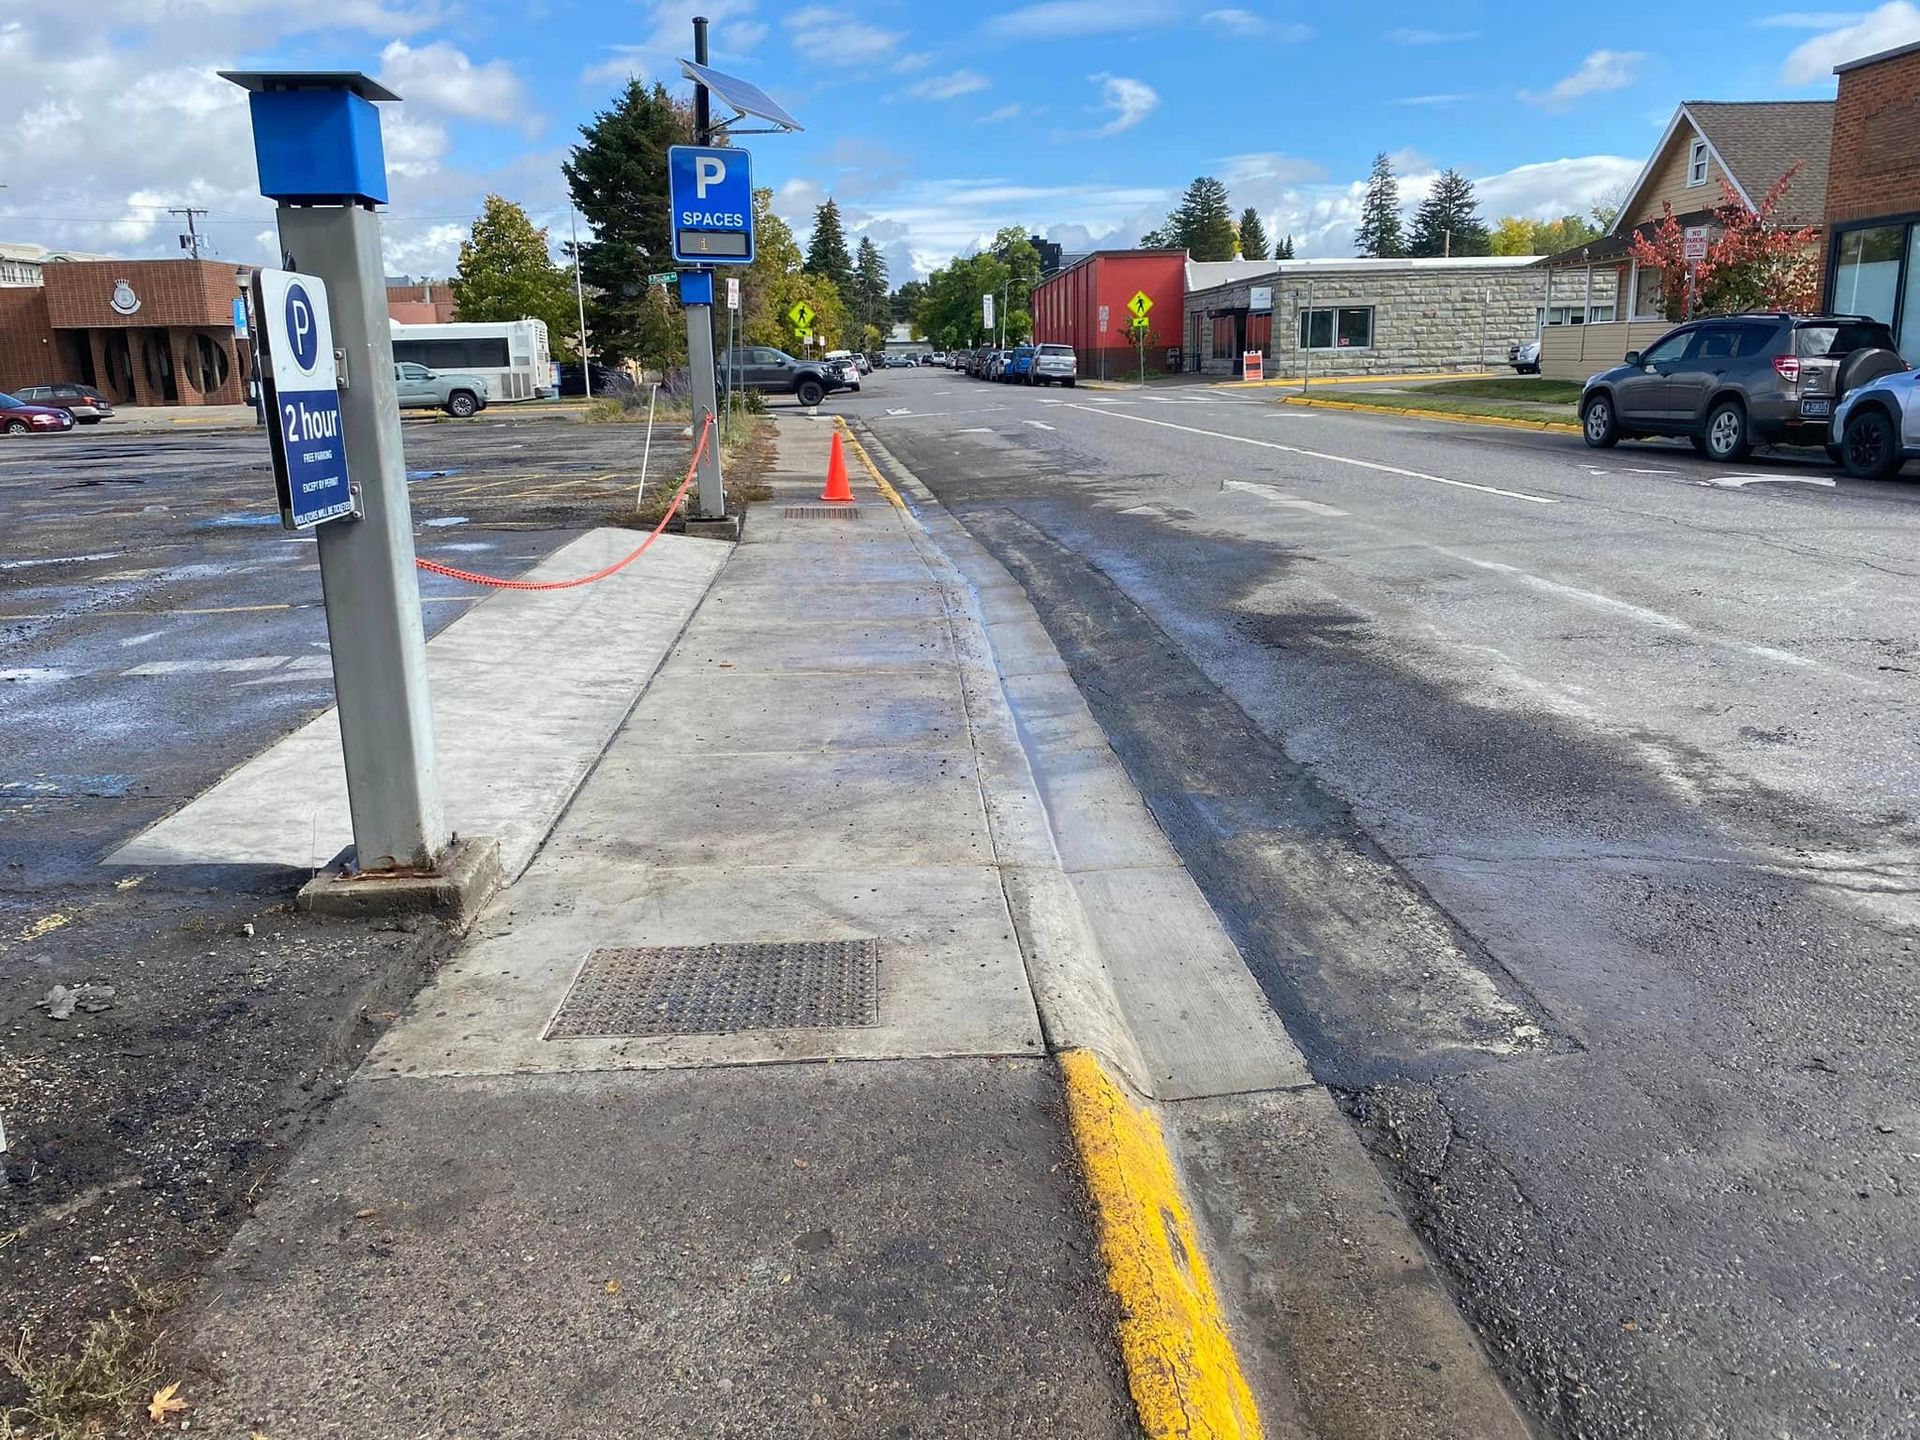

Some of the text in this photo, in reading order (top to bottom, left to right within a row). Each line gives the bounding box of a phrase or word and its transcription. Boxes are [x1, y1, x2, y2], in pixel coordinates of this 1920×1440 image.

[695, 157, 726, 199] P
[682, 212, 743, 227] SPACES
[293, 300, 309, 355] P
[285, 402, 337, 442] 2 hour
[303, 449, 333, 463] FREE PARKING
[302, 476, 339, 493] EXCEPT BY PERMIT
[318, 508, 328, 519] WILL
[327, 505, 334, 515] BE
